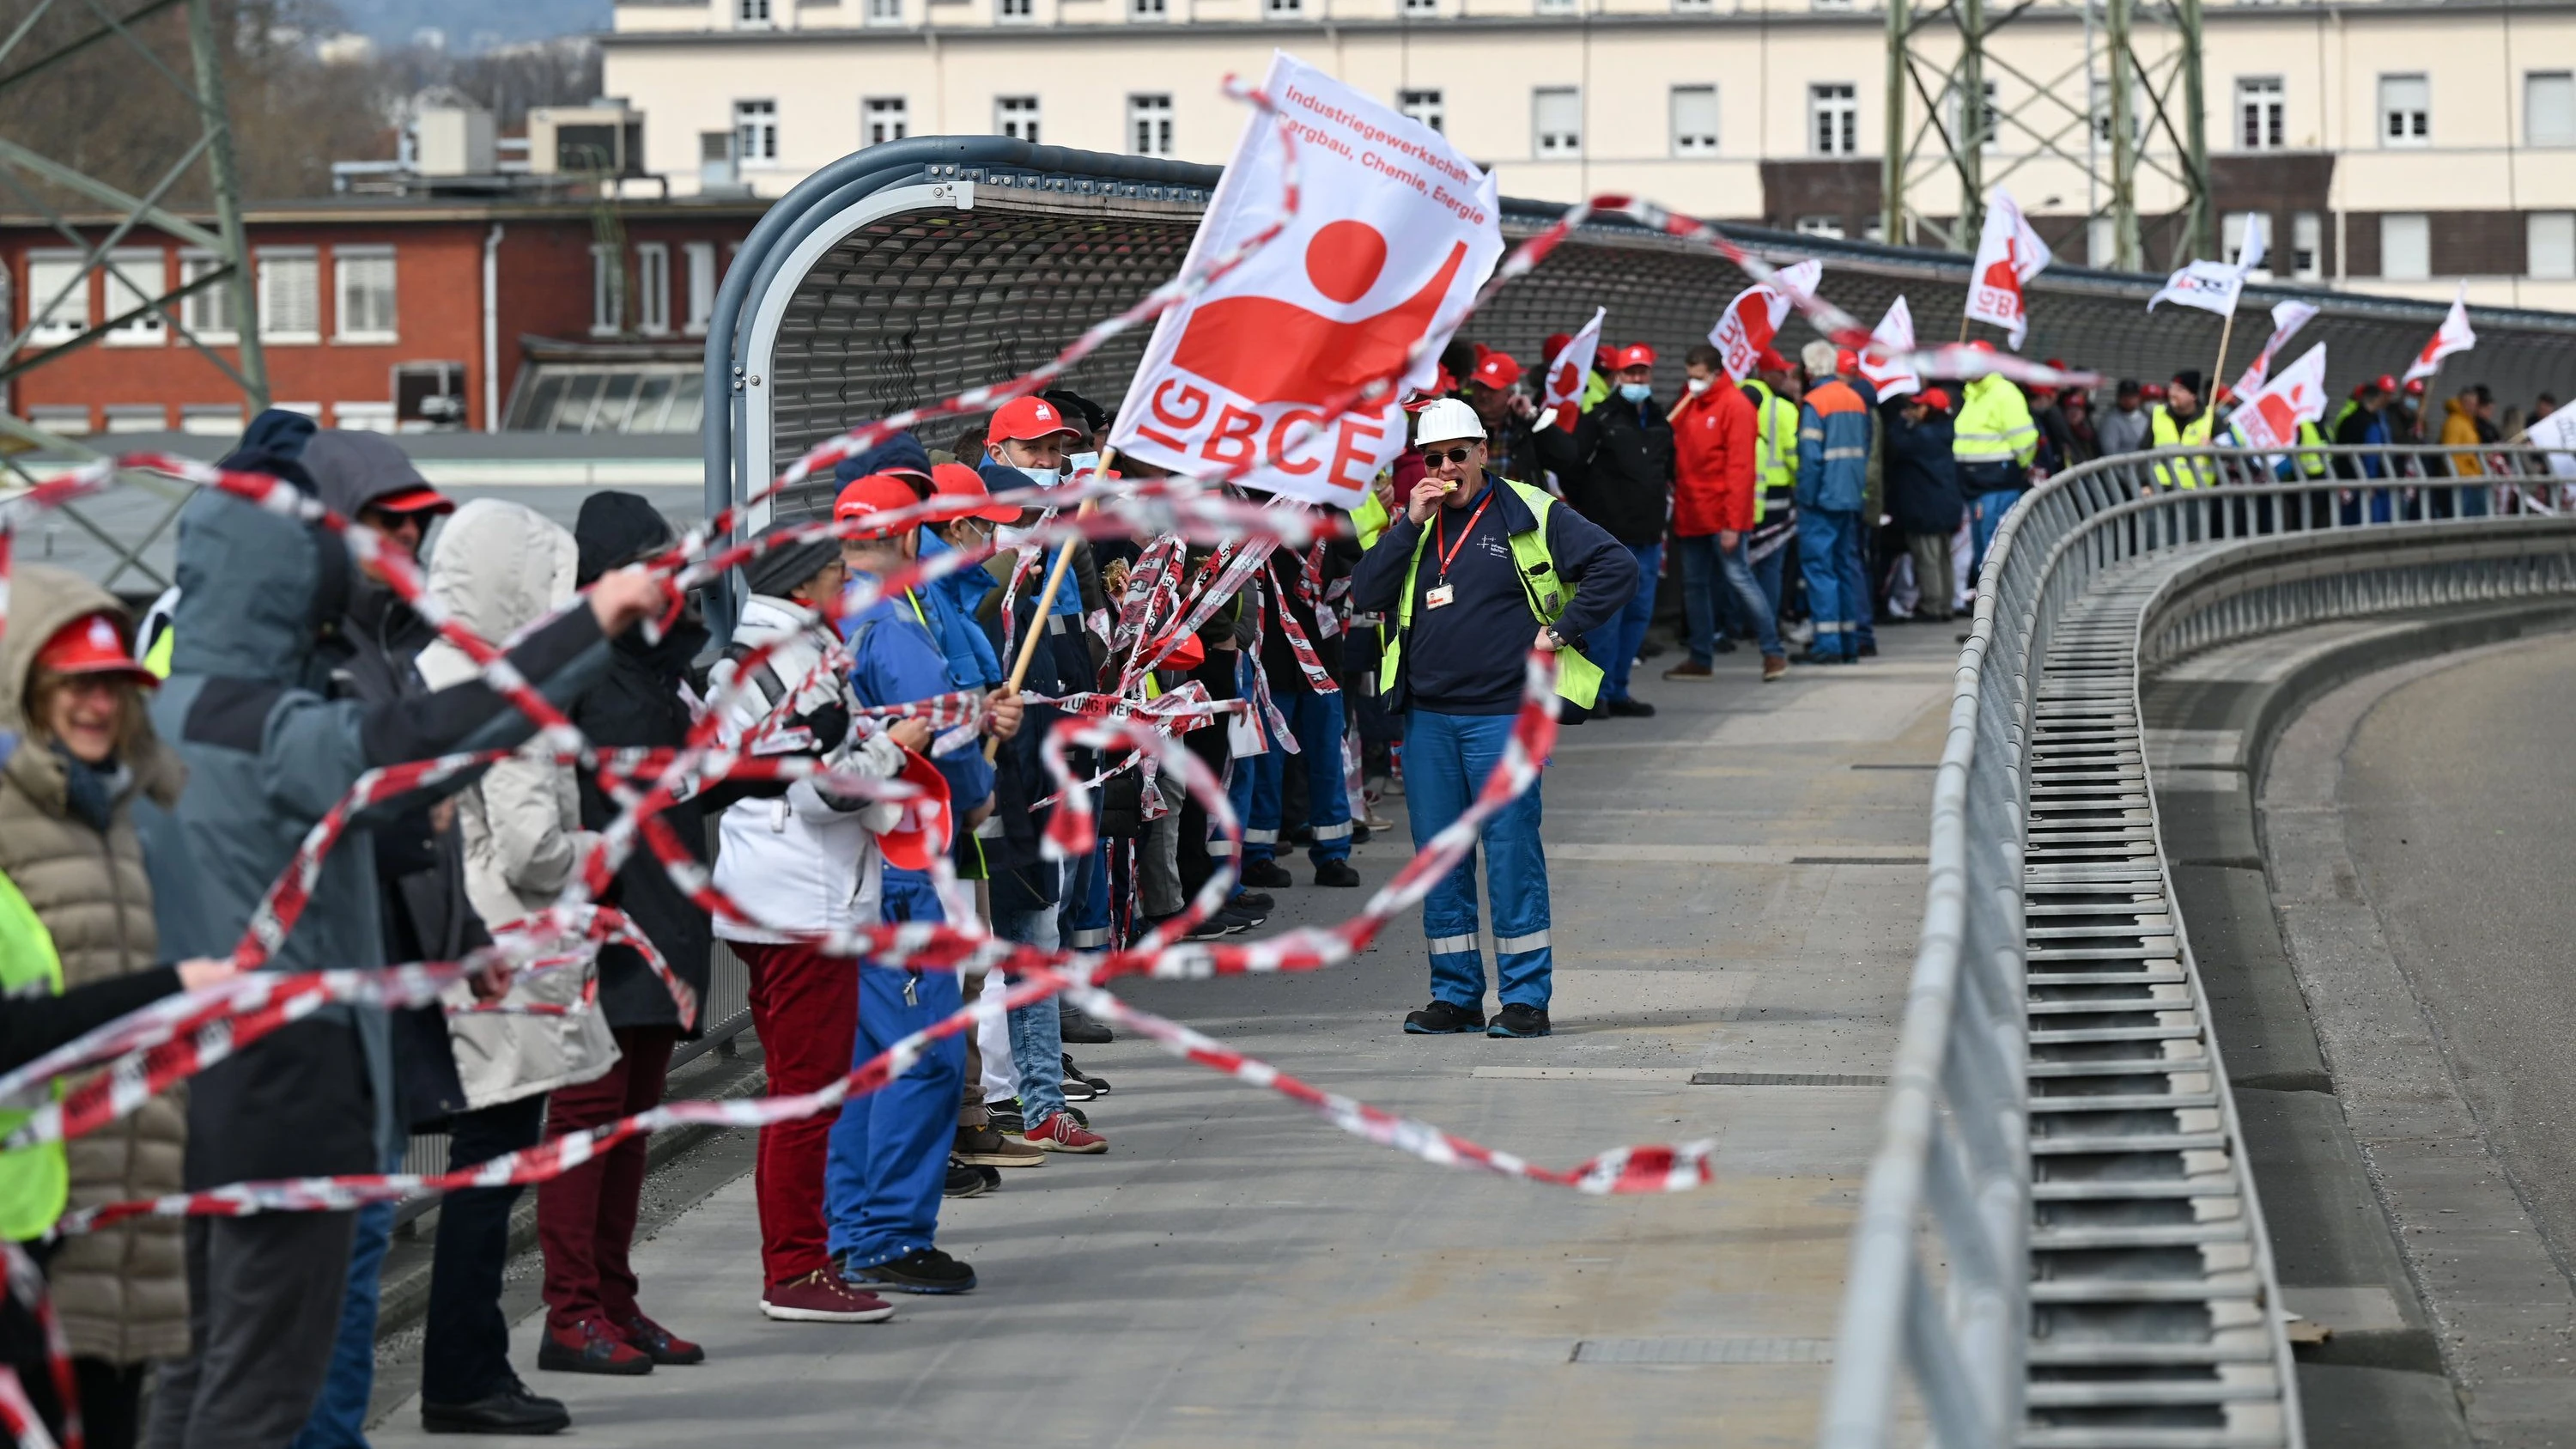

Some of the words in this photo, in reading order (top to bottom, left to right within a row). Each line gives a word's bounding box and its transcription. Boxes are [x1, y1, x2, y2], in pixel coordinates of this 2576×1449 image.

[1285, 83, 1469, 186] Industriegewerkschaft
[1361, 150, 1428, 196] Chemie,
[1432, 184, 1485, 225] Energie
[1200, 403, 1384, 492] BCE
[1055, 697, 1103, 713] TUNG:
